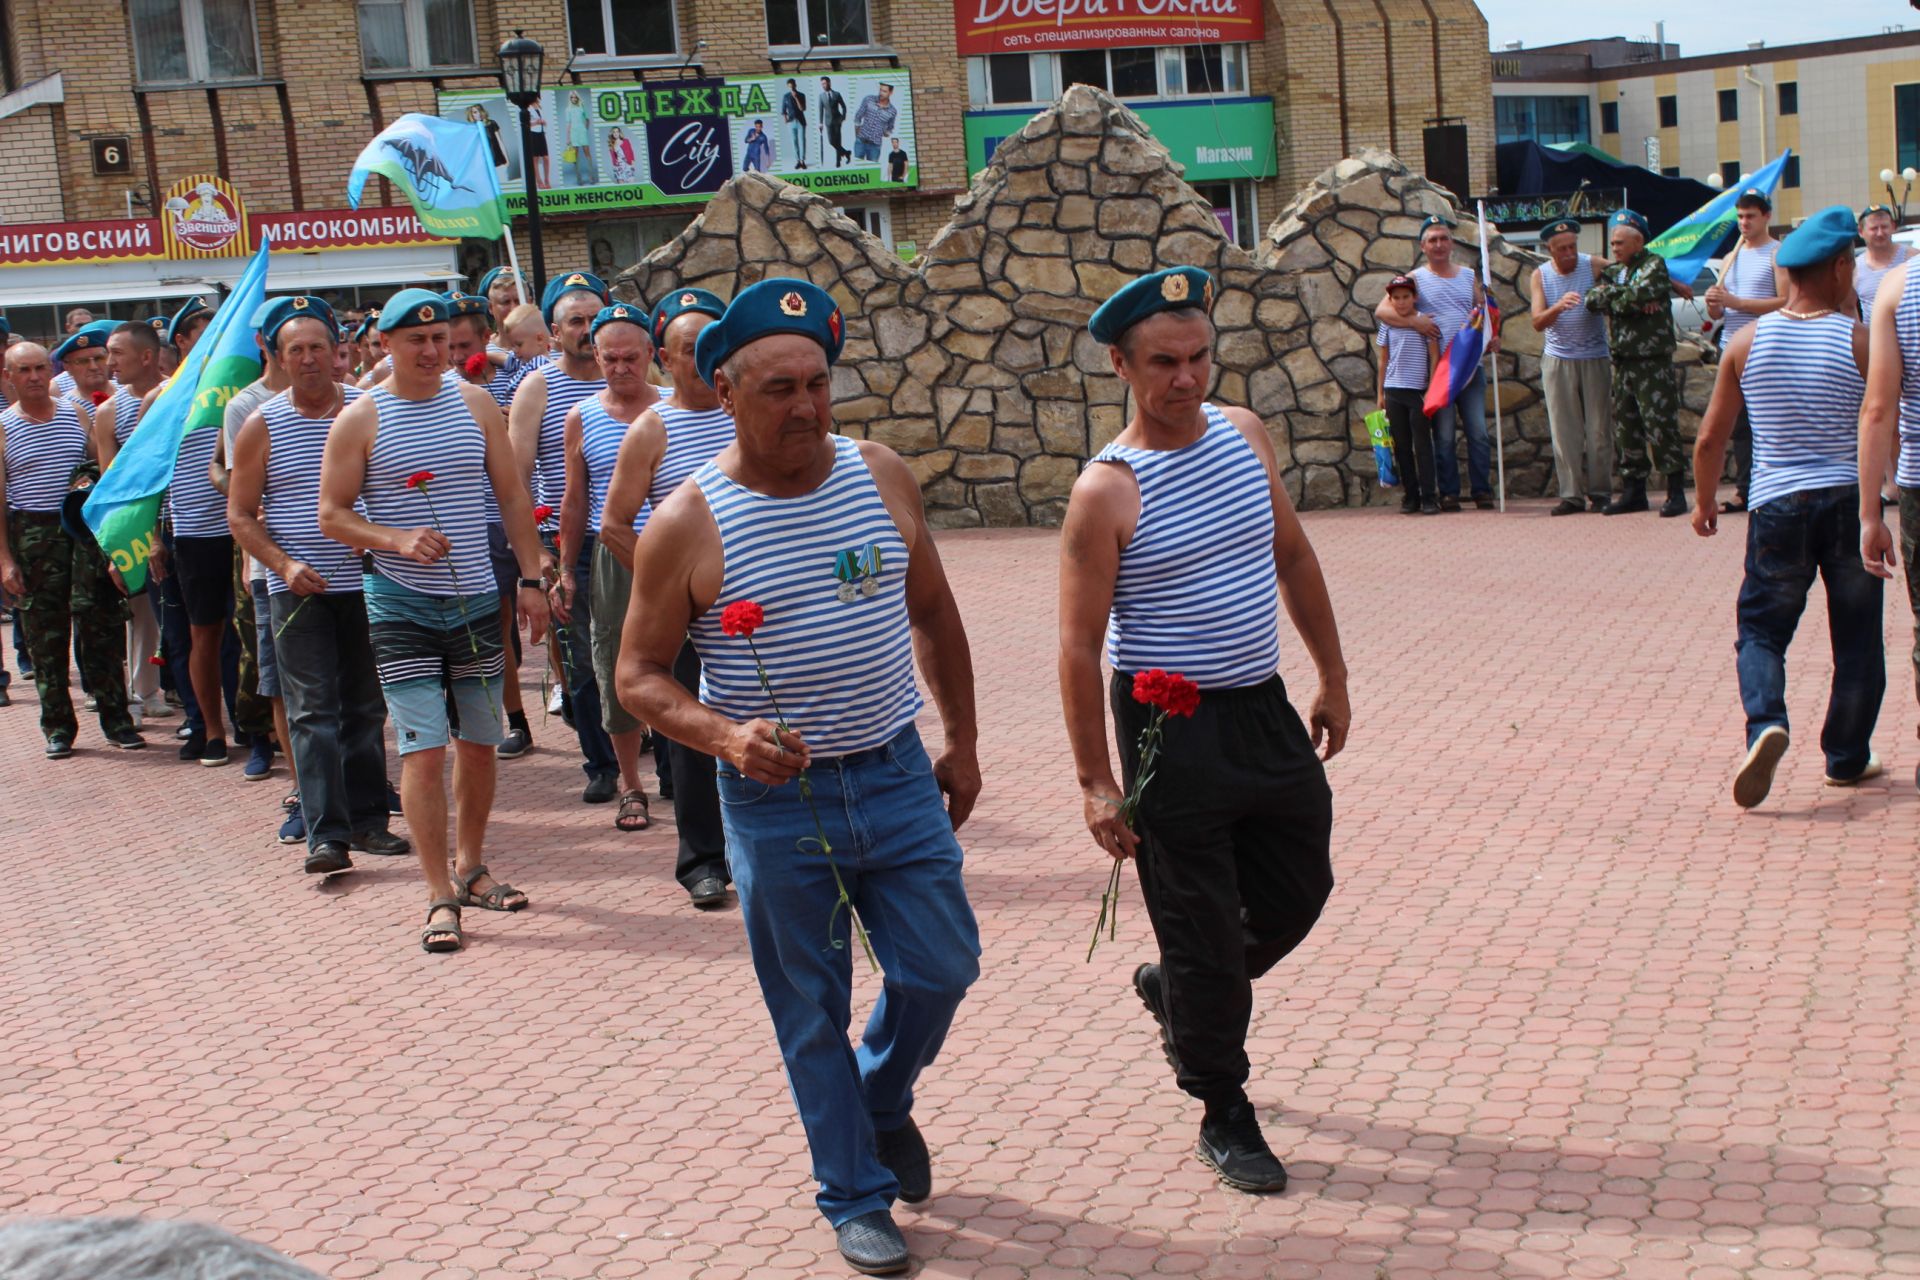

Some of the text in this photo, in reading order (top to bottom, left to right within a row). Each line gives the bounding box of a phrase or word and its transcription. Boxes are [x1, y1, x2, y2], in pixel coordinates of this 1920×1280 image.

[1003, 26, 1220, 46] сеть специализированных салонов
[598, 84, 772, 123] ОДЕЖДА
[104, 146, 120, 164] 6
[661, 121, 721, 190] City
[1196, 146, 1253, 164] Магазин
[506, 194, 570, 209] МААЗИН
[574, 186, 643, 205] ЖЕНСКОЙ
[814, 173, 870, 187] ОДЕЖДЫ
